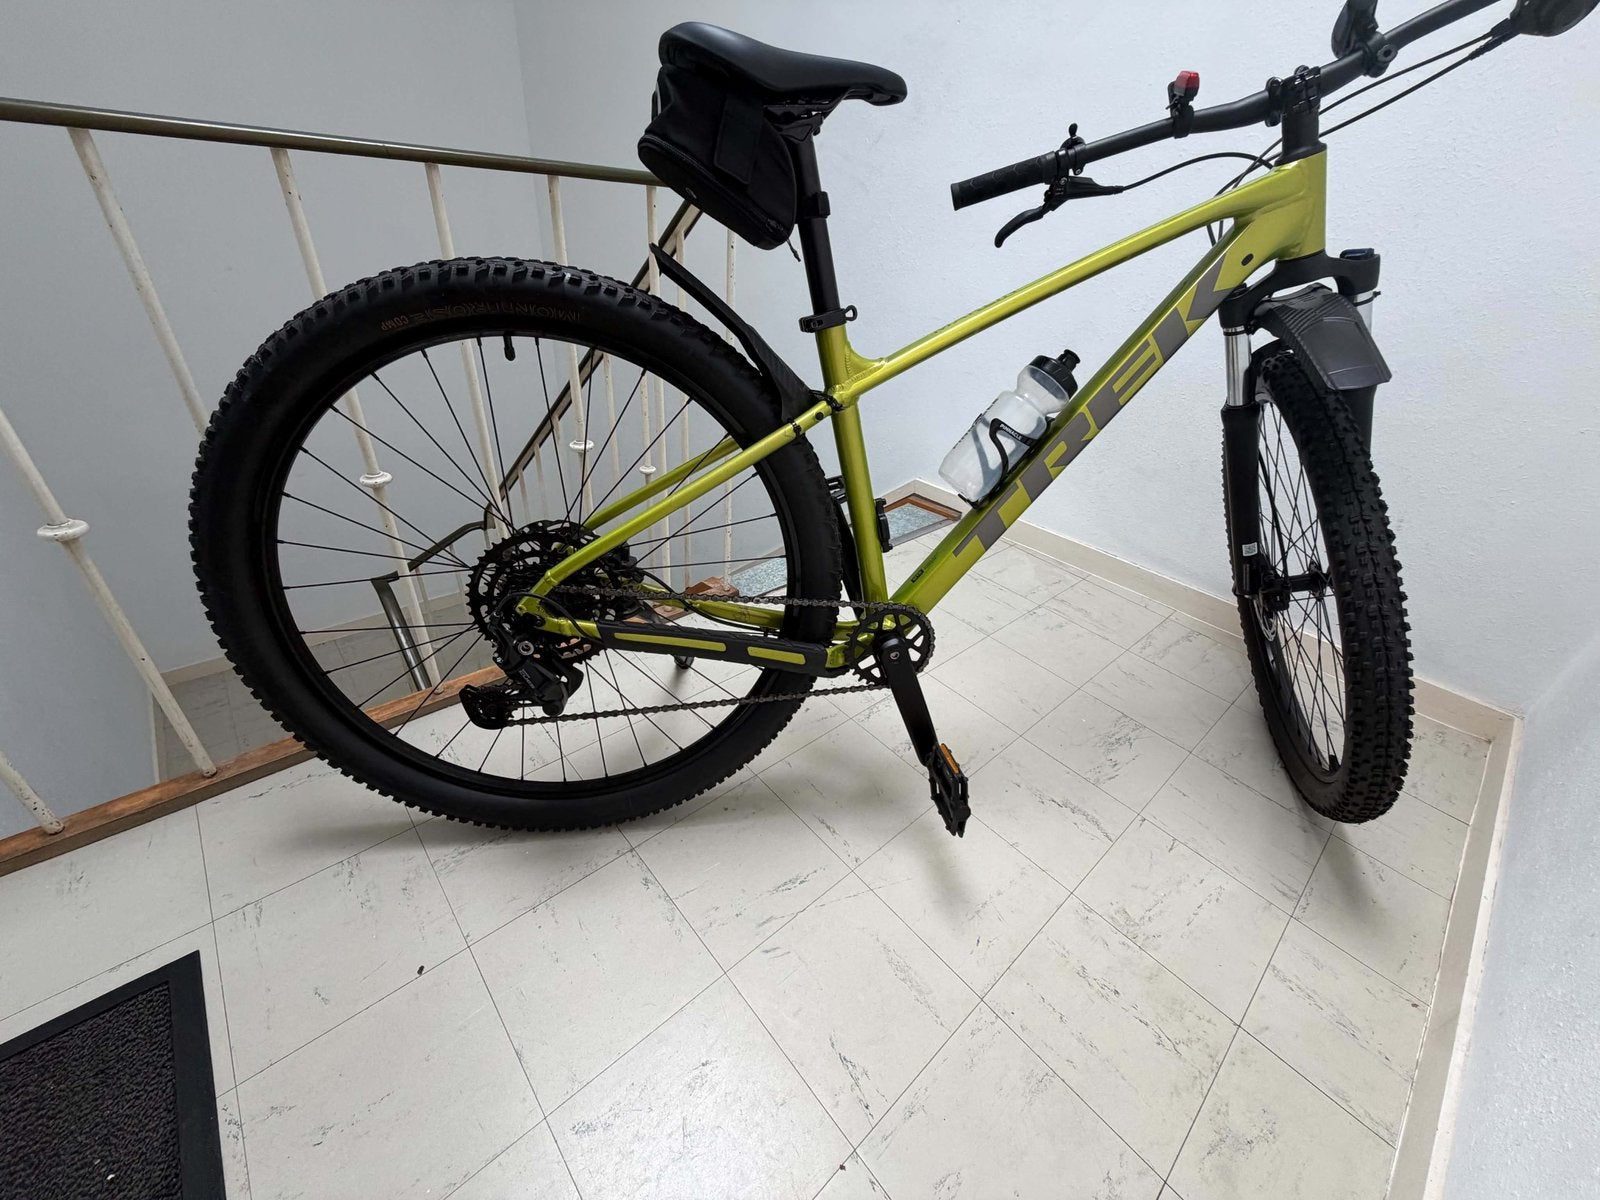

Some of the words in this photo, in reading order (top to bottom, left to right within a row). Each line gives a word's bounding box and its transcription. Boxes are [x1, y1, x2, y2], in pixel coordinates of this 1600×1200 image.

[381, 315, 409, 331] COMP
[952, 251, 1235, 558] TREK
[1000, 423, 1022, 441] PINNACLE
